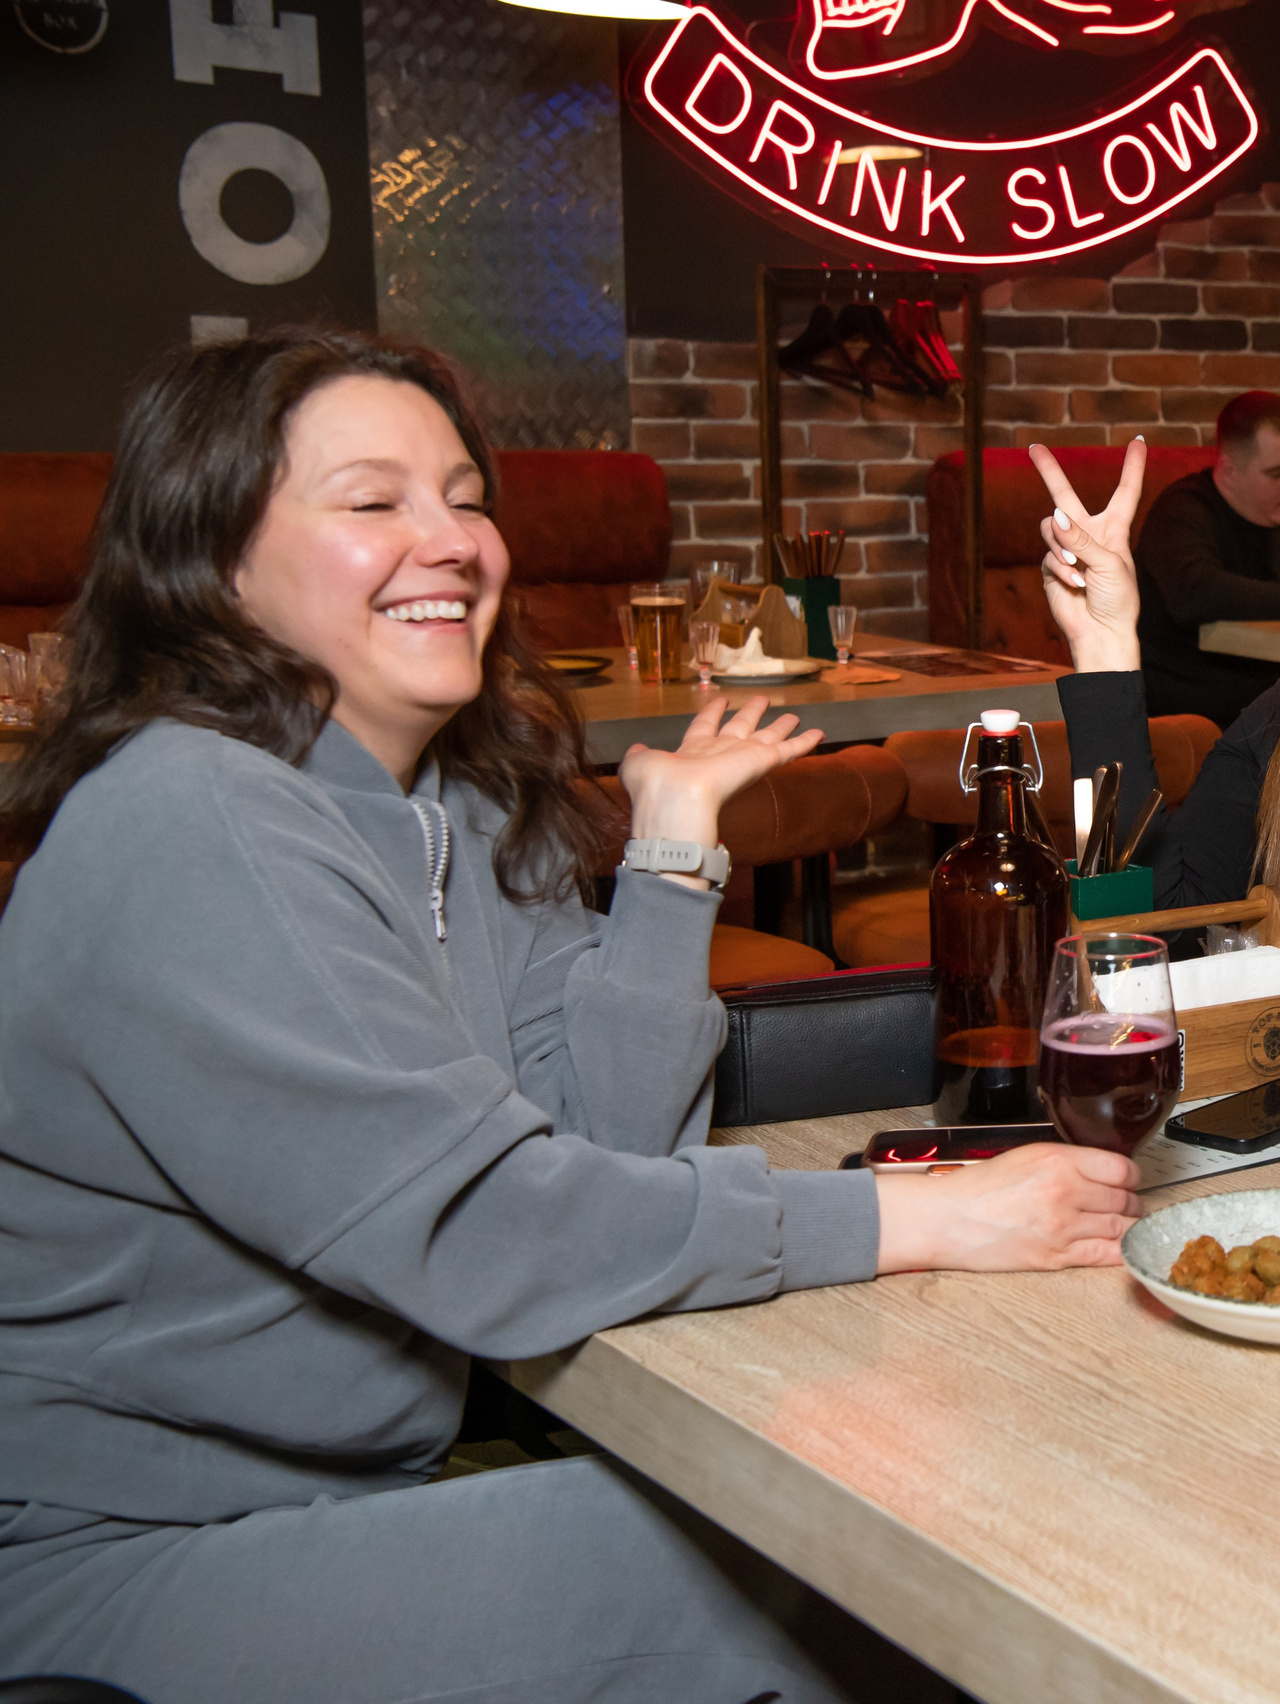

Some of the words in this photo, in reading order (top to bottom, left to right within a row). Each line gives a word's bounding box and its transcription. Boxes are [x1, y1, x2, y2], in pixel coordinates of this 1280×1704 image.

[685, 52, 969, 243] DRINK
[1006, 85, 1218, 240] SLOW
[1252, 1012, 1273, 1033] TOP
